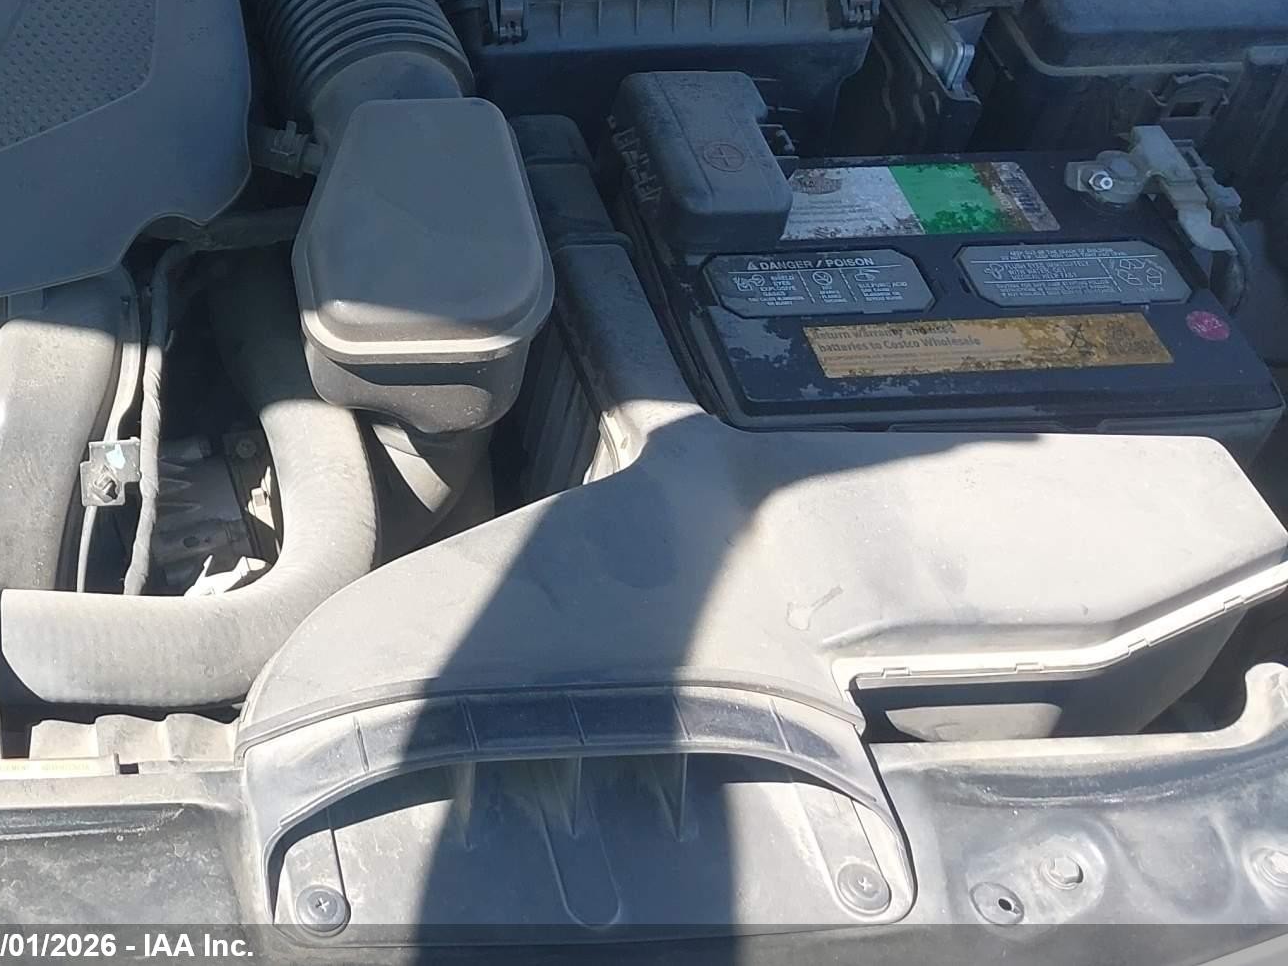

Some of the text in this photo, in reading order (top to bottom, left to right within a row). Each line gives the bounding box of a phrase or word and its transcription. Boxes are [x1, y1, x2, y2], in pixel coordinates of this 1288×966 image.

[759, 259, 812, 271] DANGER
[824, 257, 875, 268] POISON
[818, 335, 982, 353] batteries to Costco Wholesale
